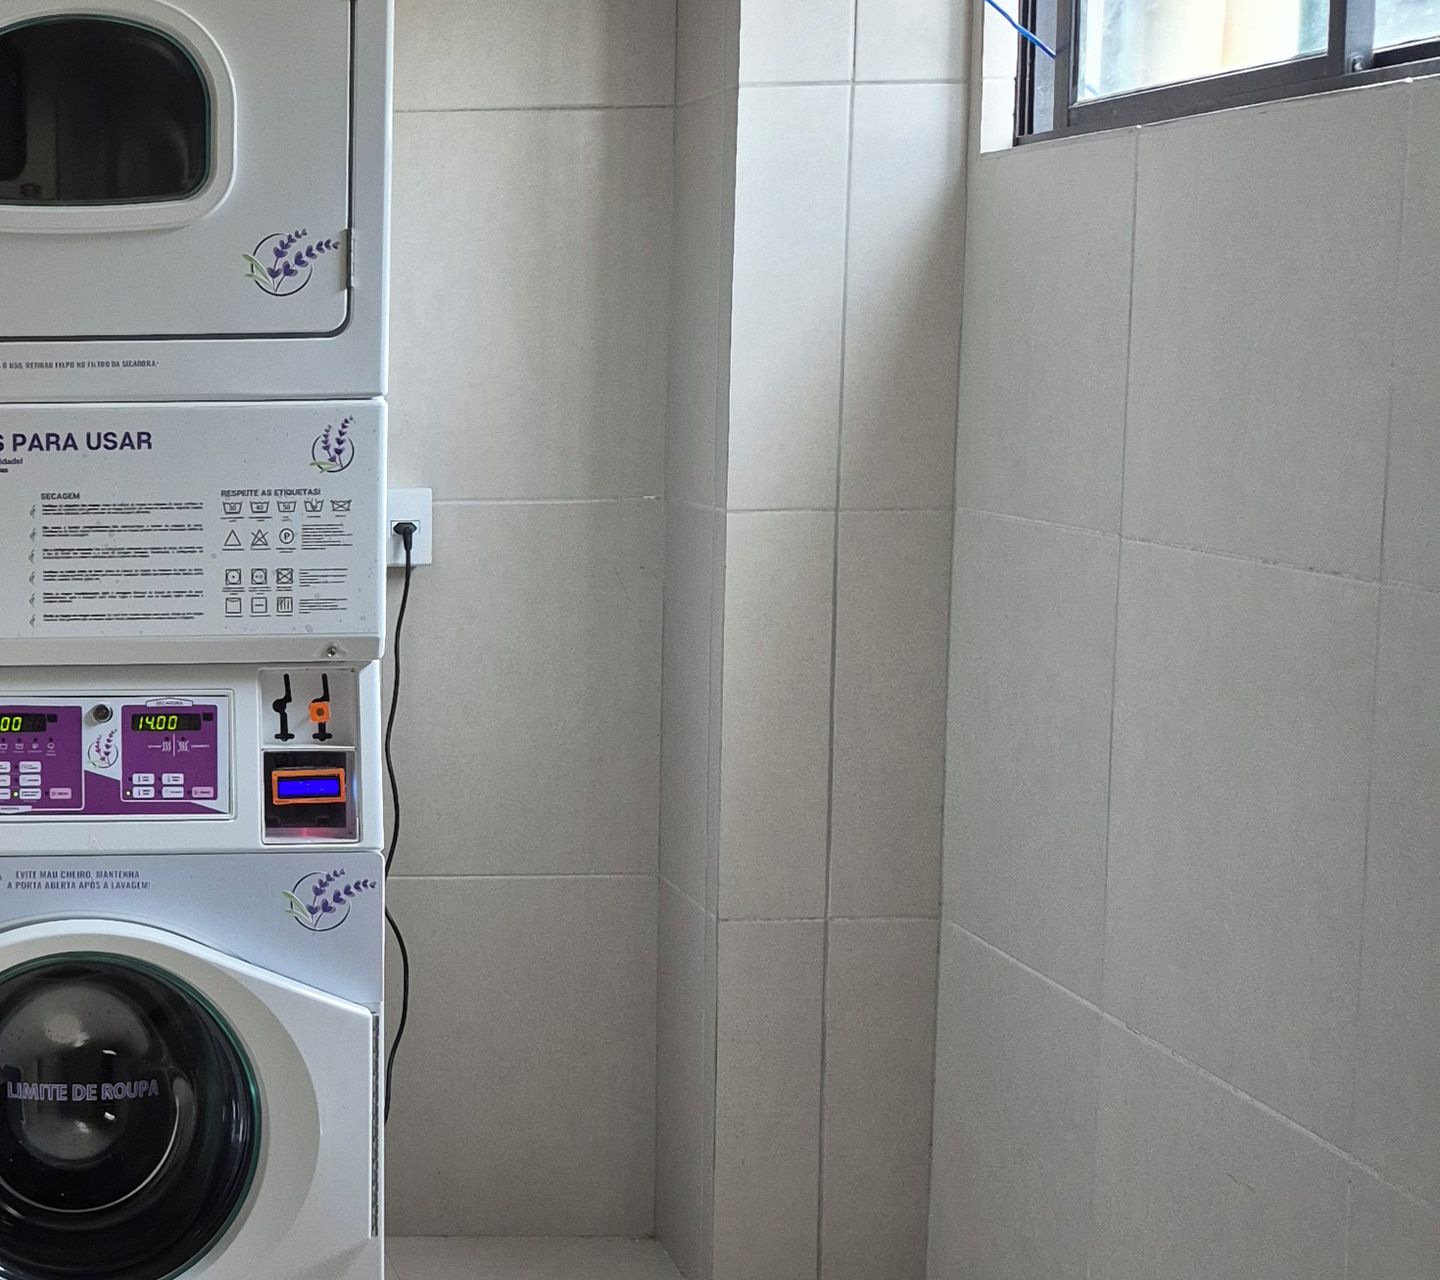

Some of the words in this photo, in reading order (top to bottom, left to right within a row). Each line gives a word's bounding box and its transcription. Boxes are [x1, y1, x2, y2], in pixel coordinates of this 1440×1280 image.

[12, 433, 79, 452] PARA
[85, 431, 153, 451] USAR
[274, 488, 321, 496] ETIQUETAS!
[139, 715, 178, 730] 14.00
[96, 870, 140, 878] MANTENHA
[79, 879, 100, 889] APÓS
[7, 1081, 68, 1101] LIMITE
[71, 1083, 97, 1101] DE
[101, 1079, 159, 1100] ROUPA
